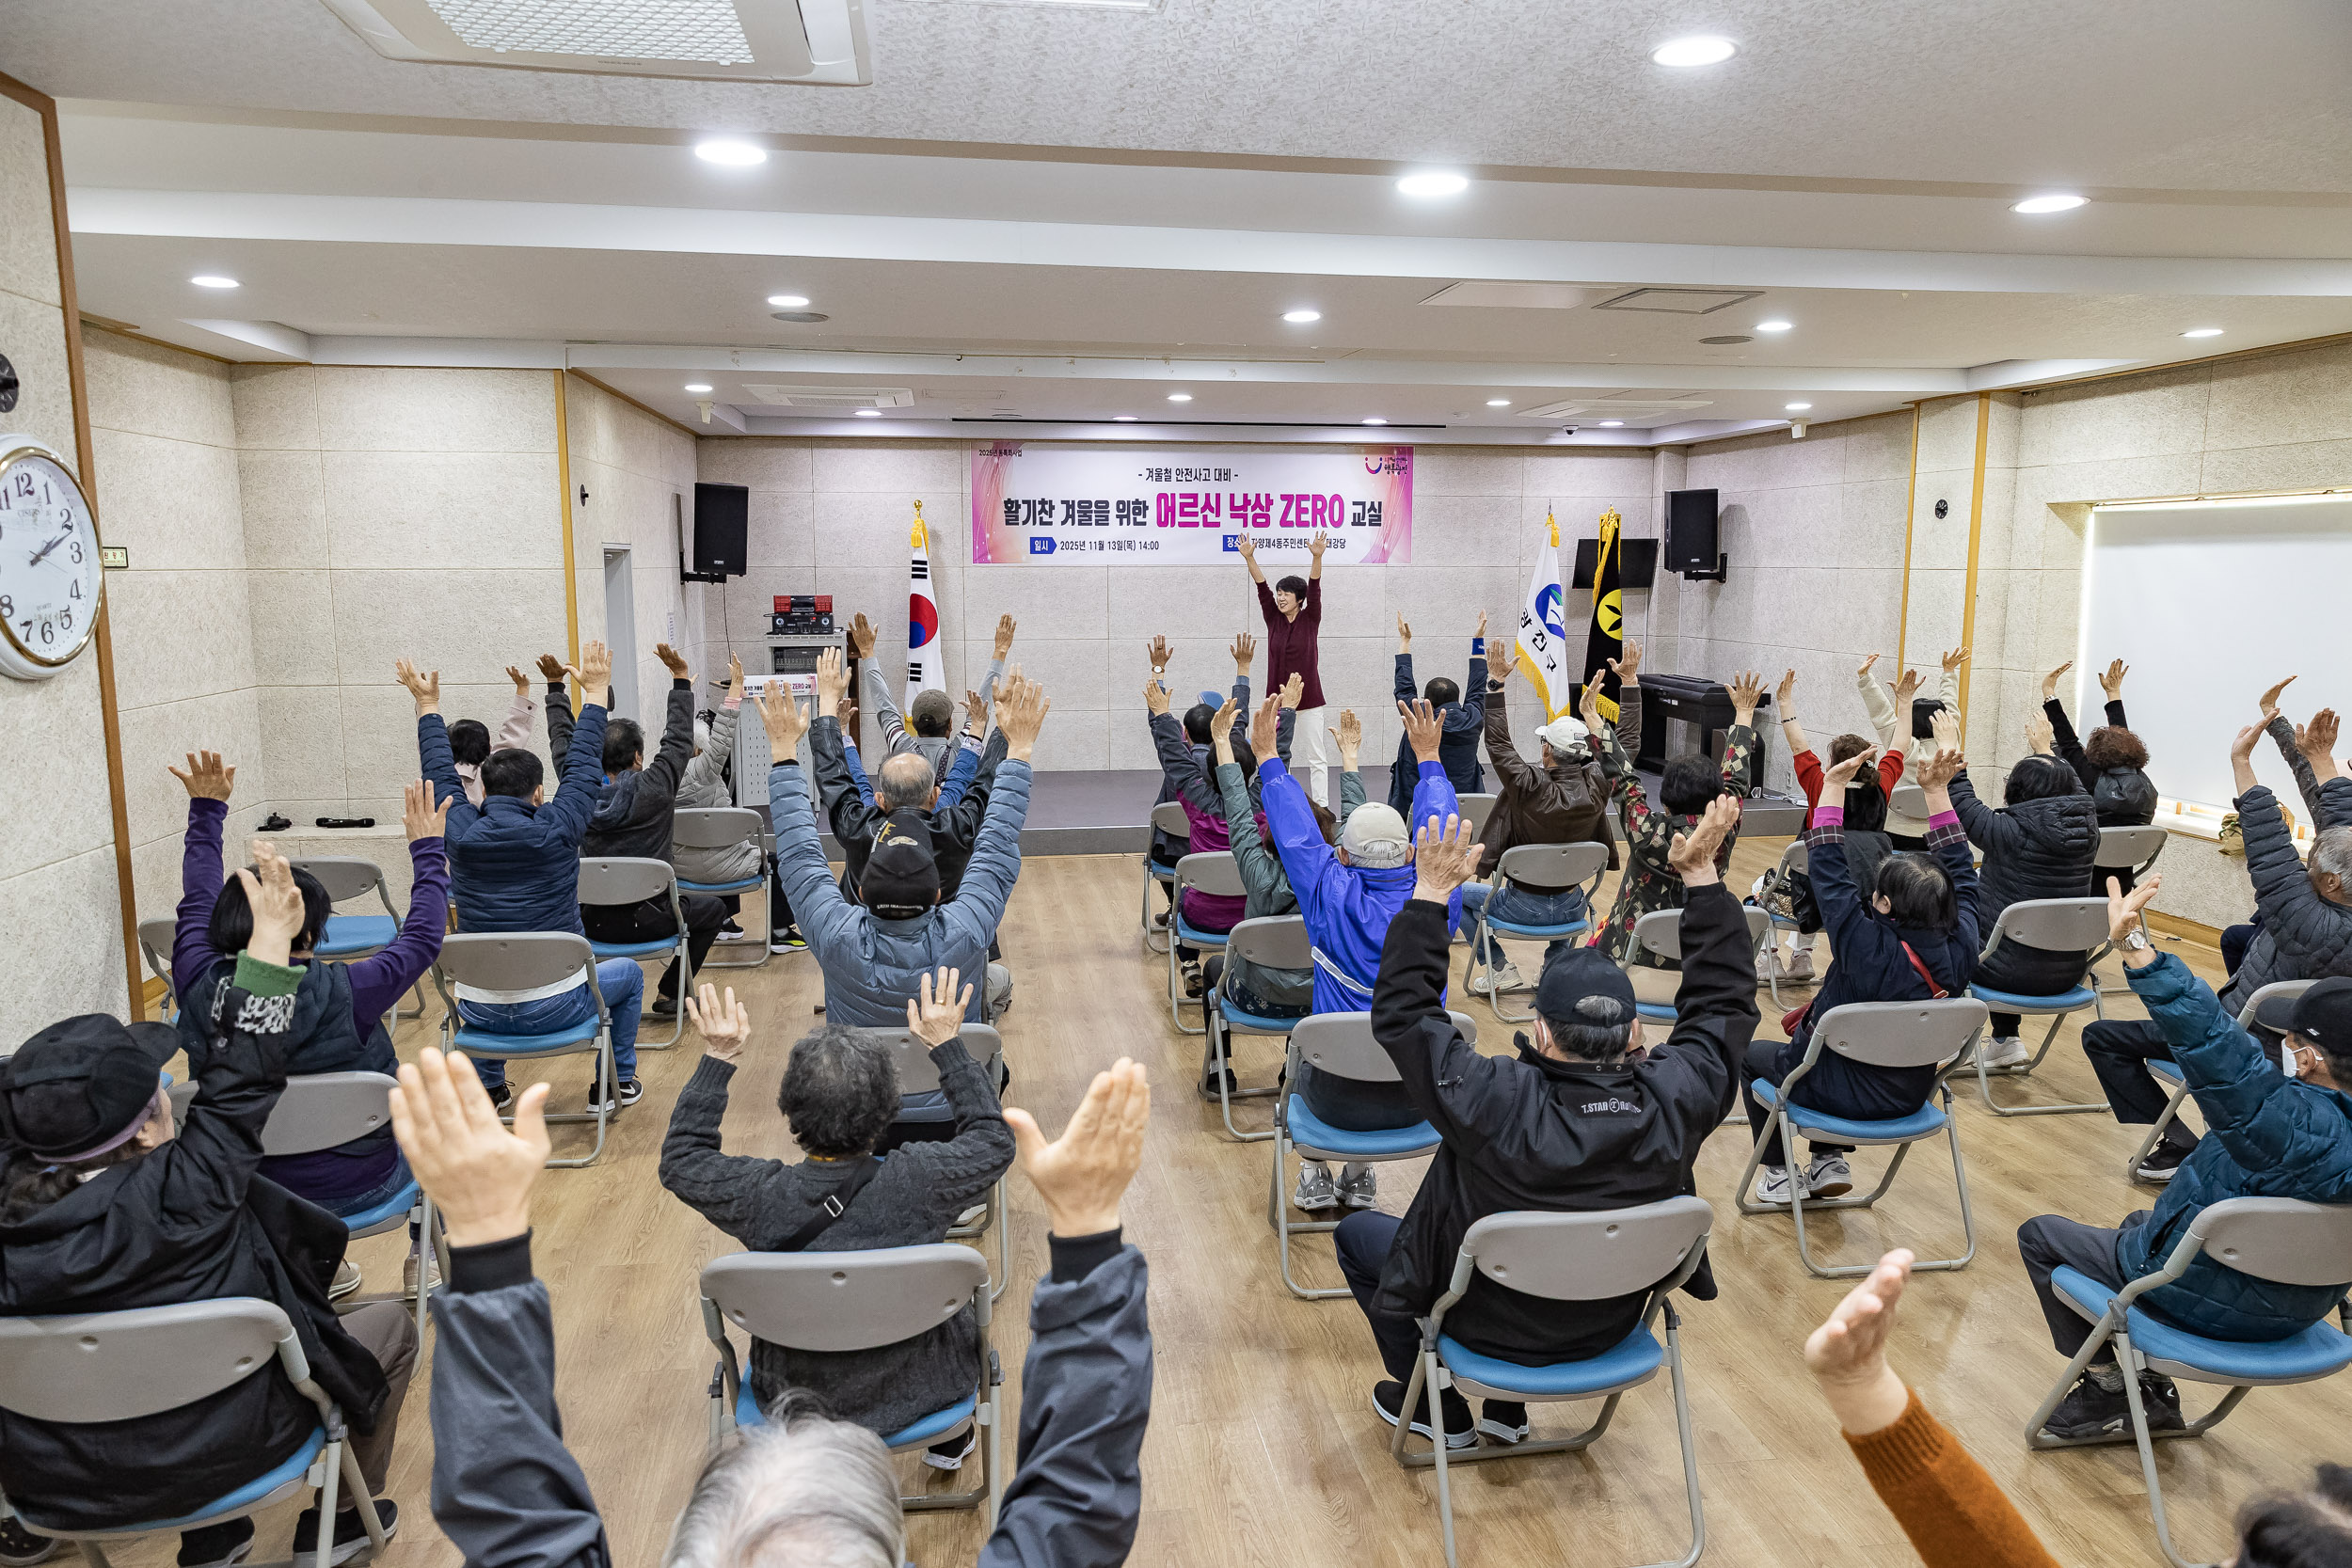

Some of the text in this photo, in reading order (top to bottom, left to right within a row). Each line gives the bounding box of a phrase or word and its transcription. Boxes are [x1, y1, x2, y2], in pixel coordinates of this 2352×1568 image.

[15, 472, 35, 498] 12
[1145, 467, 1172, 483] 겨울철
[1175, 467, 1211, 483] 안전사고
[1215, 467, 1232, 483] 대비
[43, 481, 54, 505] 1
[59, 508, 74, 531] 2
[1004, 492, 1383, 529] 활기찬 겨울을 위한 어르신 낙상 ZERO 교실
[70, 541, 83, 564] 3
[1034, 539, 1159, 552] 일시 2025년 11월 13일(목) 14:00
[70, 578, 83, 601] 4
[0, 594, 15, 618] 8
[59, 605, 73, 630] 5
[20, 619, 34, 642] 7
[40, 621, 55, 644] 6
[1581, 1101, 1609, 1114] T.STAR
